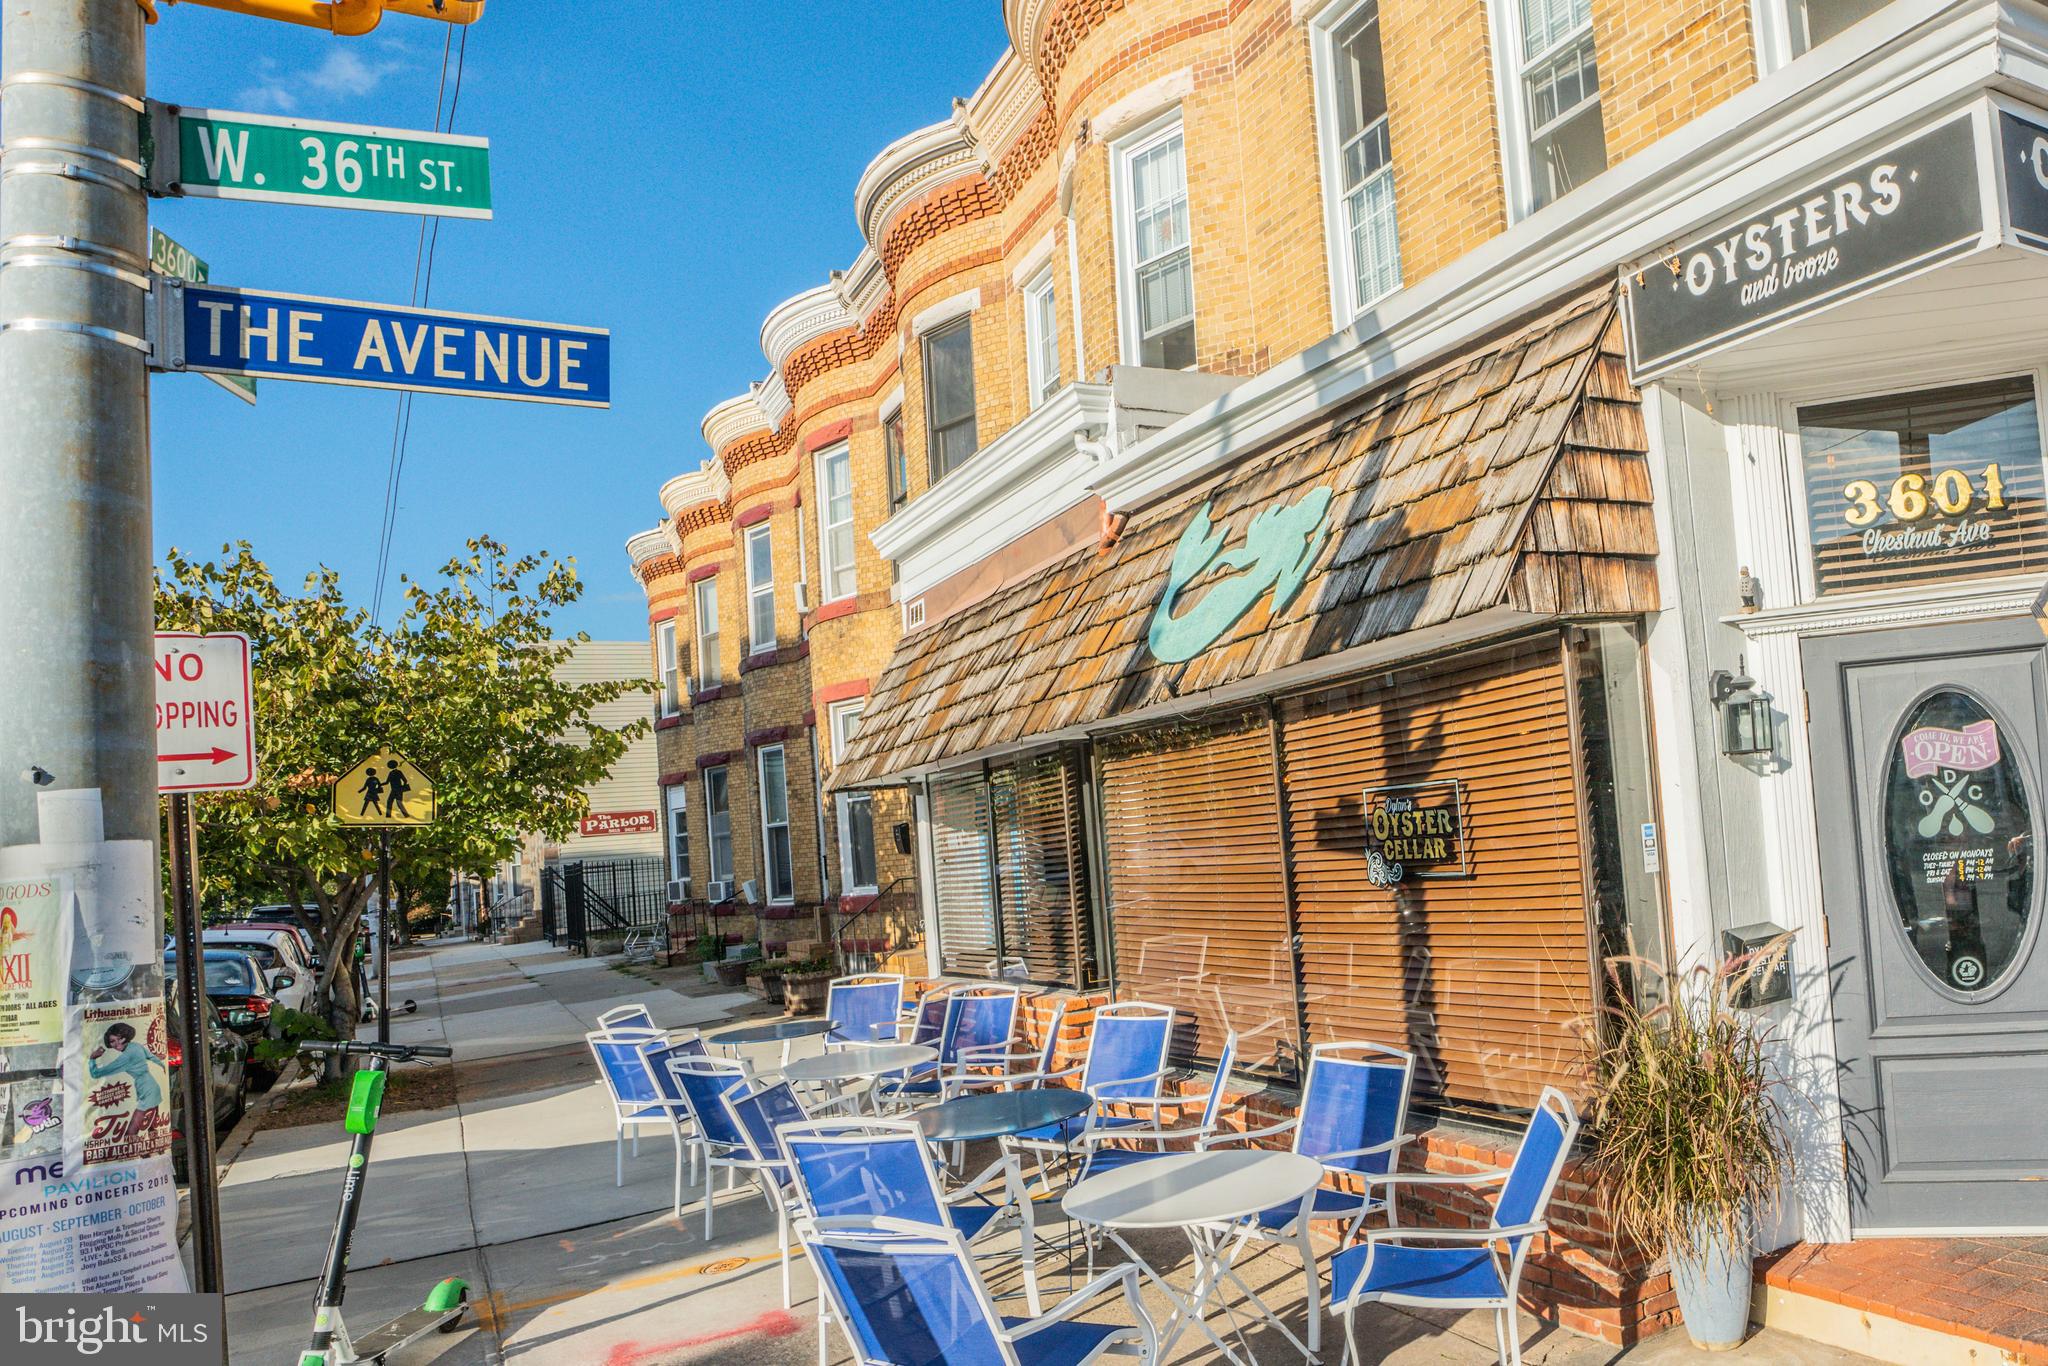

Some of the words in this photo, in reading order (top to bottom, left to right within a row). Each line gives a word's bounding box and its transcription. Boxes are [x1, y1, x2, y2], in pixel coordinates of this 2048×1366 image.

[198, 127, 266, 184] W.
[301, 136, 405, 192] 36TH
[419, 160, 463, 193] ST.
[1685, 164, 1902, 296] OYSTERS
[157, 234, 197, 283] 3600
[1741, 272, 1780, 306] and
[1783, 245, 1840, 288] booze
[197, 300, 324, 367] THE
[353, 318, 589, 391] AVENUE
[1843, 462, 2007, 528] 3601
[1863, 522, 1944, 554] Chestnut
[1947, 519, 1991, 548] Ave
[154, 652, 204, 682] NO
[1914, 731, 1938, 744] COME
[1953, 735, 1964, 744] WE
[1968, 734, 1984, 745] ARE
[1914, 741, 1988, 764] OPEN
[585, 815, 650, 832] PARLOR
[1372, 807, 1454, 841] OYSTER
[1383, 837, 1448, 861] CELLAR
[1922, 850, 1948, 862] CLOSED
[1949, 850, 1960, 860] ON
[1960, 848, 1994, 858] MONDAYS
[38, 1000, 58, 1009] AGES
[84, 1006, 136, 1020] Lithuanian
[86, 1148, 110, 1161] BABY
[112, 1140, 152, 1156] ALCATRAZ
[44, 1168, 138, 1198] PAVILION
[75, 1182, 144, 1206] CONCERTS
[0, 1224, 43, 1244] UGUST
[52, 1208, 122, 1233] SEPTEMBER
[128, 1196, 166, 1217] OCTOBER
[108, 1232, 124, 1242] Molly
